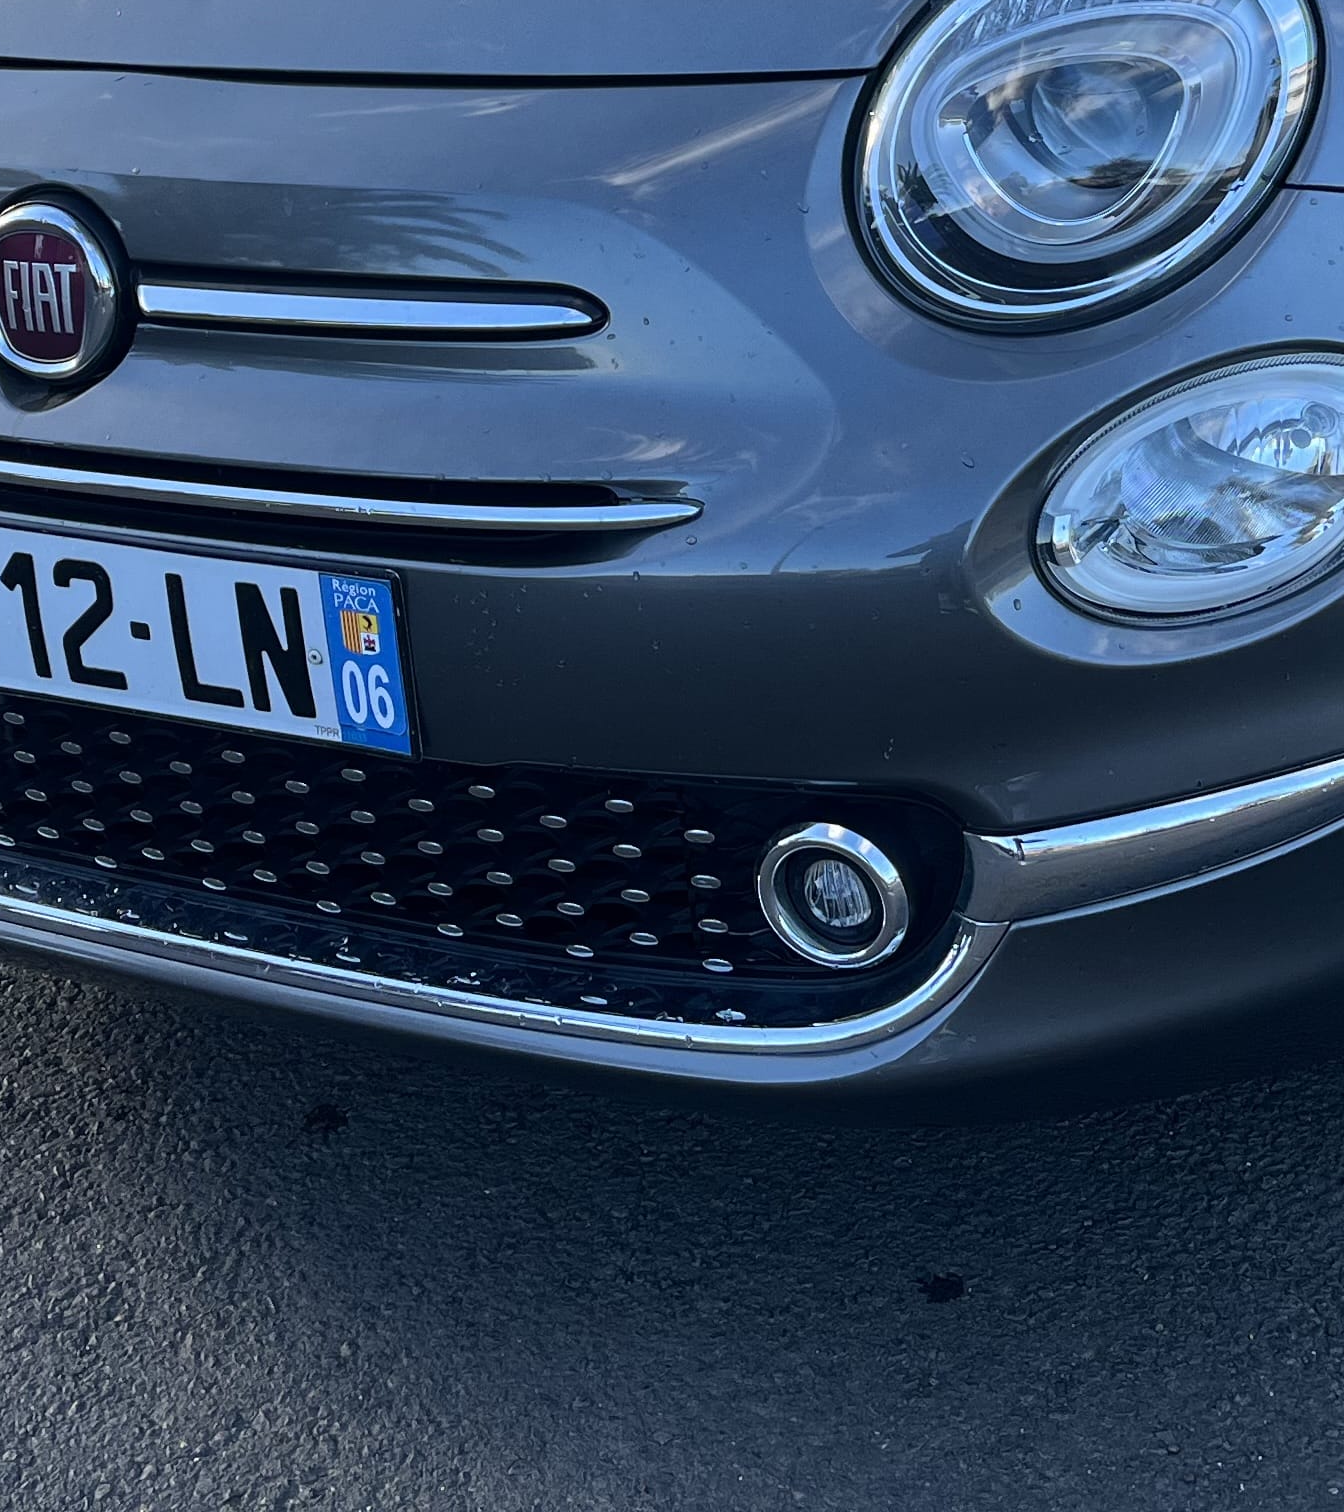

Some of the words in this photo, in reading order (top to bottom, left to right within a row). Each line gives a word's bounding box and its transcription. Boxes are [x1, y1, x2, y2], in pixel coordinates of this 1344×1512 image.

[3, 260, 77, 334] FIAT
[332, 578, 376, 597] Région
[333, 594, 380, 613] PACA
[342, 660, 395, 729] 06
[314, 724, 340, 739] TPPR
